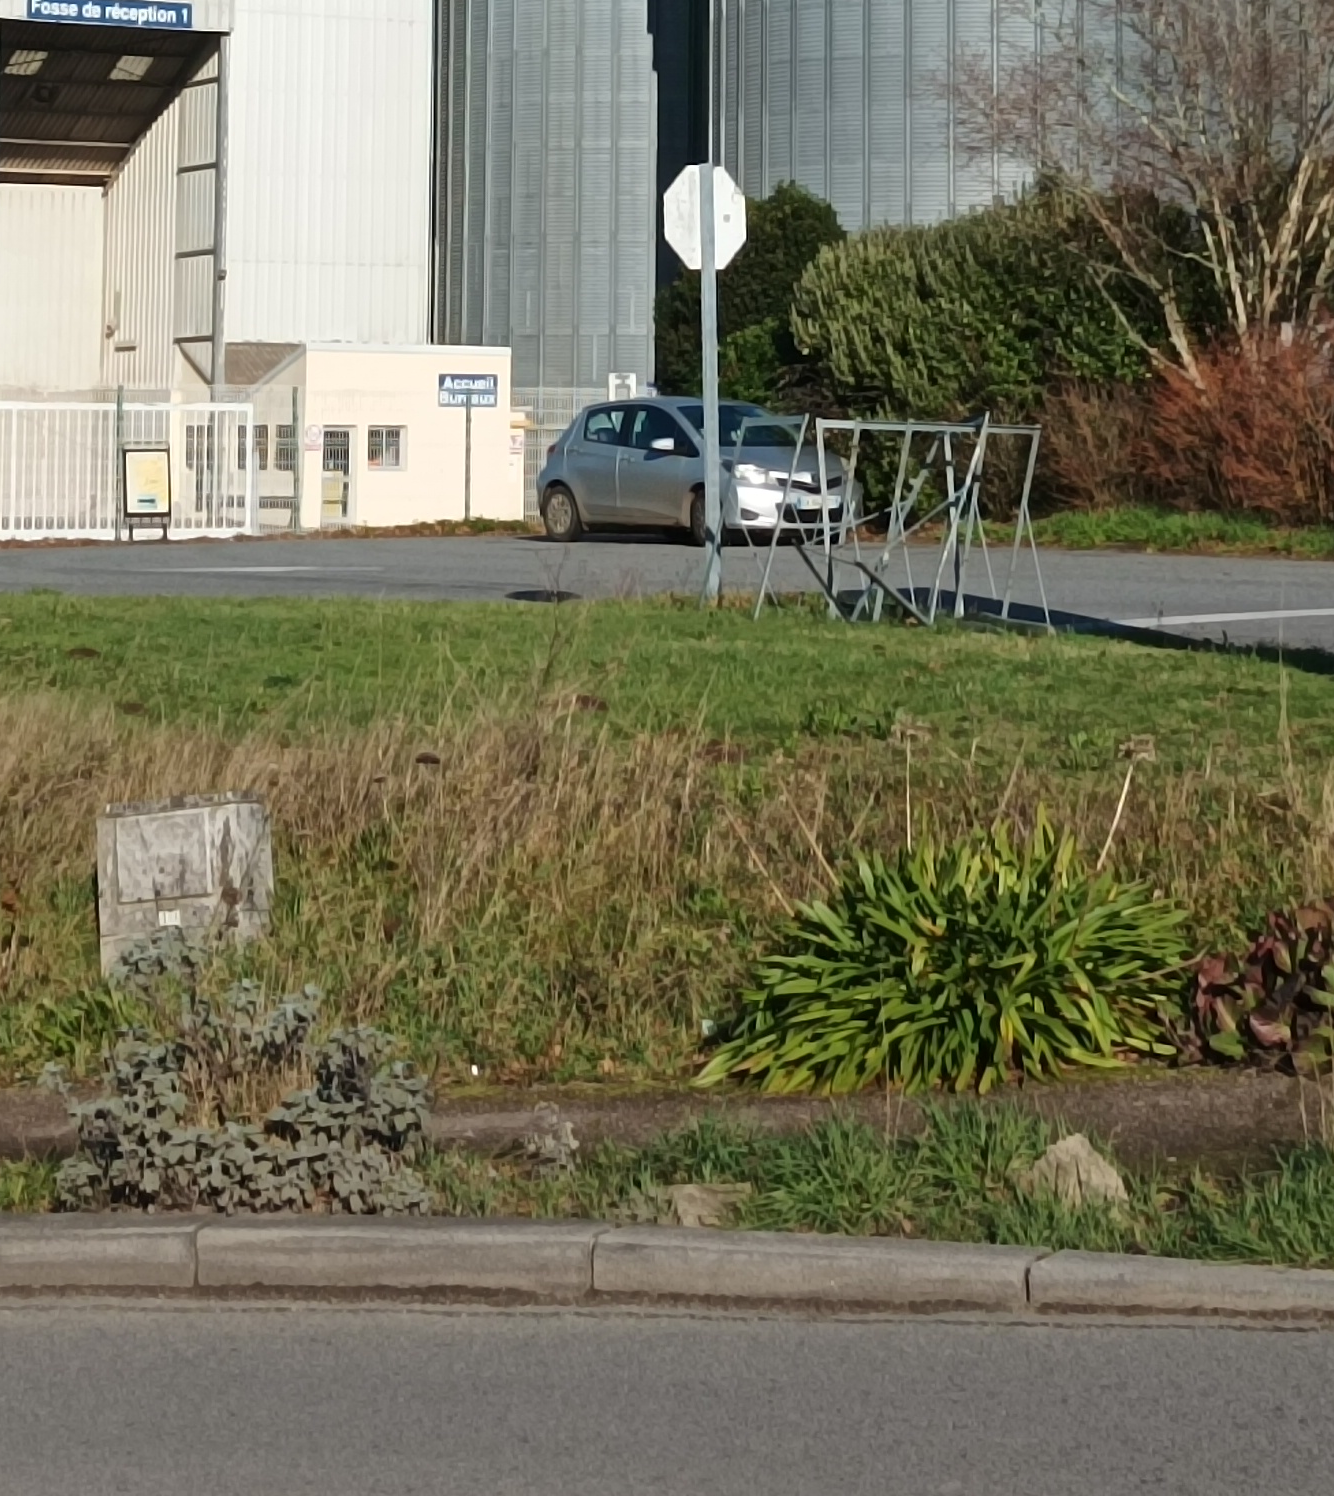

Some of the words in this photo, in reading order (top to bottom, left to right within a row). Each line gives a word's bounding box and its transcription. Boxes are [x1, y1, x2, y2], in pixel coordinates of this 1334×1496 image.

[82, 1, 101, 18] de
[105, 3, 177, 25] réception
[181, 8, 188, 24] 1
[442, 376, 494, 389] Accueil
